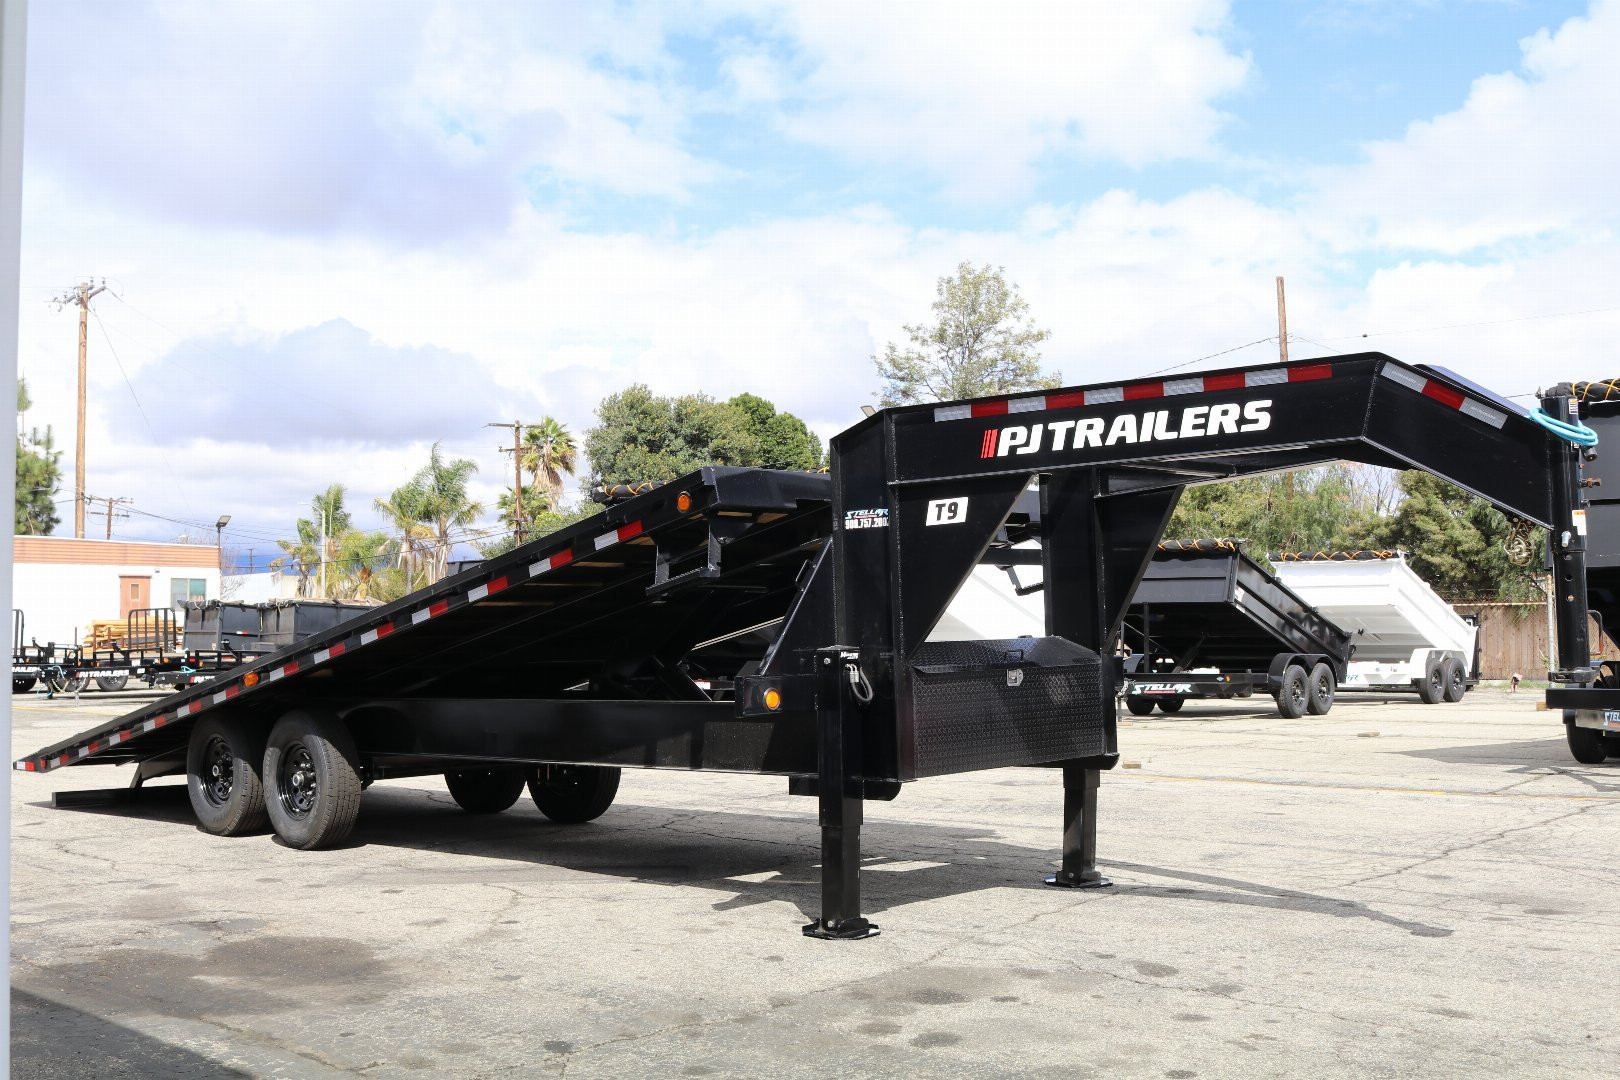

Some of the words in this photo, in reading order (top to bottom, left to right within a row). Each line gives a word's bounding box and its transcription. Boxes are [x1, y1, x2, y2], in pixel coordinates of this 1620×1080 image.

[1048, 400, 1272, 451] TRAILERS
[845, 509, 888, 519] STELLAR
[935, 502, 959, 521] T9
[1132, 684, 1192, 694] STELLAR
